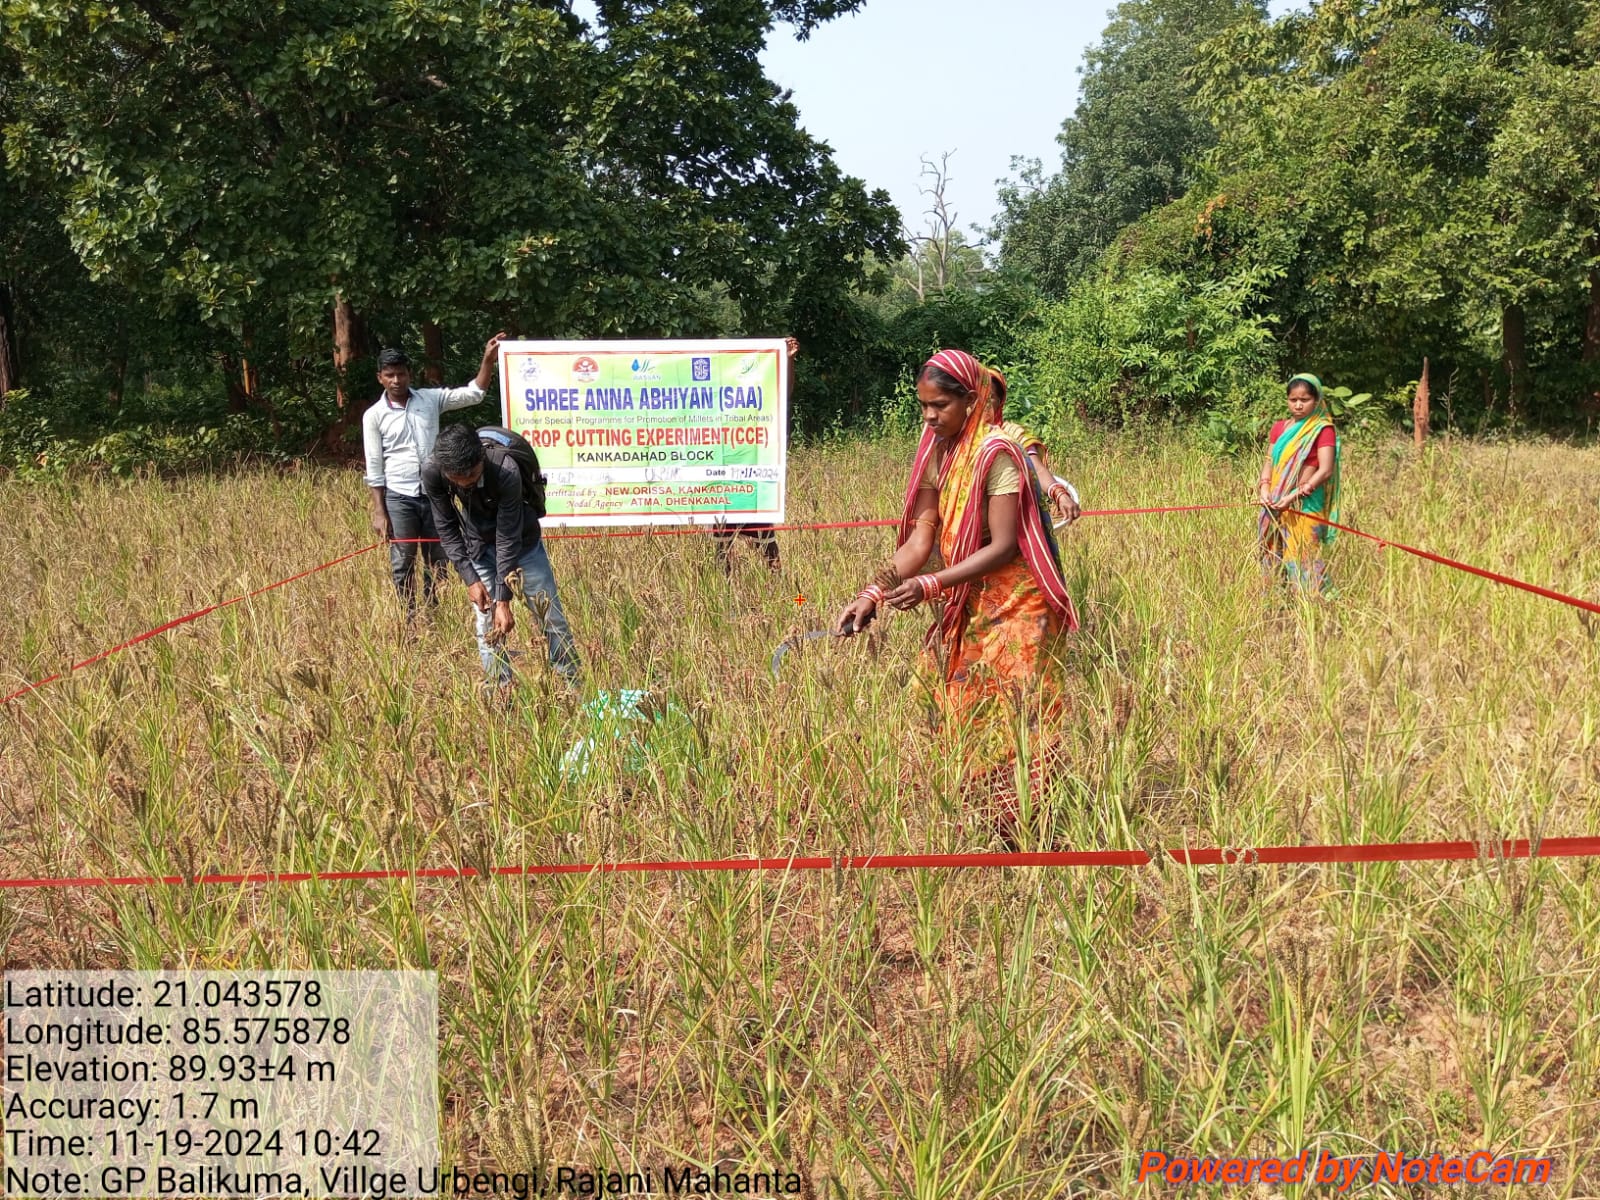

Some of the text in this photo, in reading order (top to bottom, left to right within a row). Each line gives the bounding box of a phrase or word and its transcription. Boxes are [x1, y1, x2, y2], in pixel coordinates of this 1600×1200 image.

[525, 386, 762, 412] SHREE ANNA ABHIYAN (SAA)
[515, 417, 542, 426] (Under
[544, 416, 573, 426] Special
[576, 416, 620, 426] Programme
[623, 416, 635, 424] for
[636, 415, 677, 424] Promotion
[679, 414, 687, 423] of
[688, 414, 714, 423] Millets
[725, 413, 746, 422] Tribal
[747, 413, 773, 423] Areas)
[521, 427, 769, 449] CROP CUTTING EXPERIMENT(CCE)
[577, 450, 714, 462] KANKADAHAD BLOCK
[605, 487, 629, 496] NEW
[679, 485, 754, 494] KANKADAHAD
[567, 496, 731, 509] Nodal Agency ATMA, DHENKANAL
